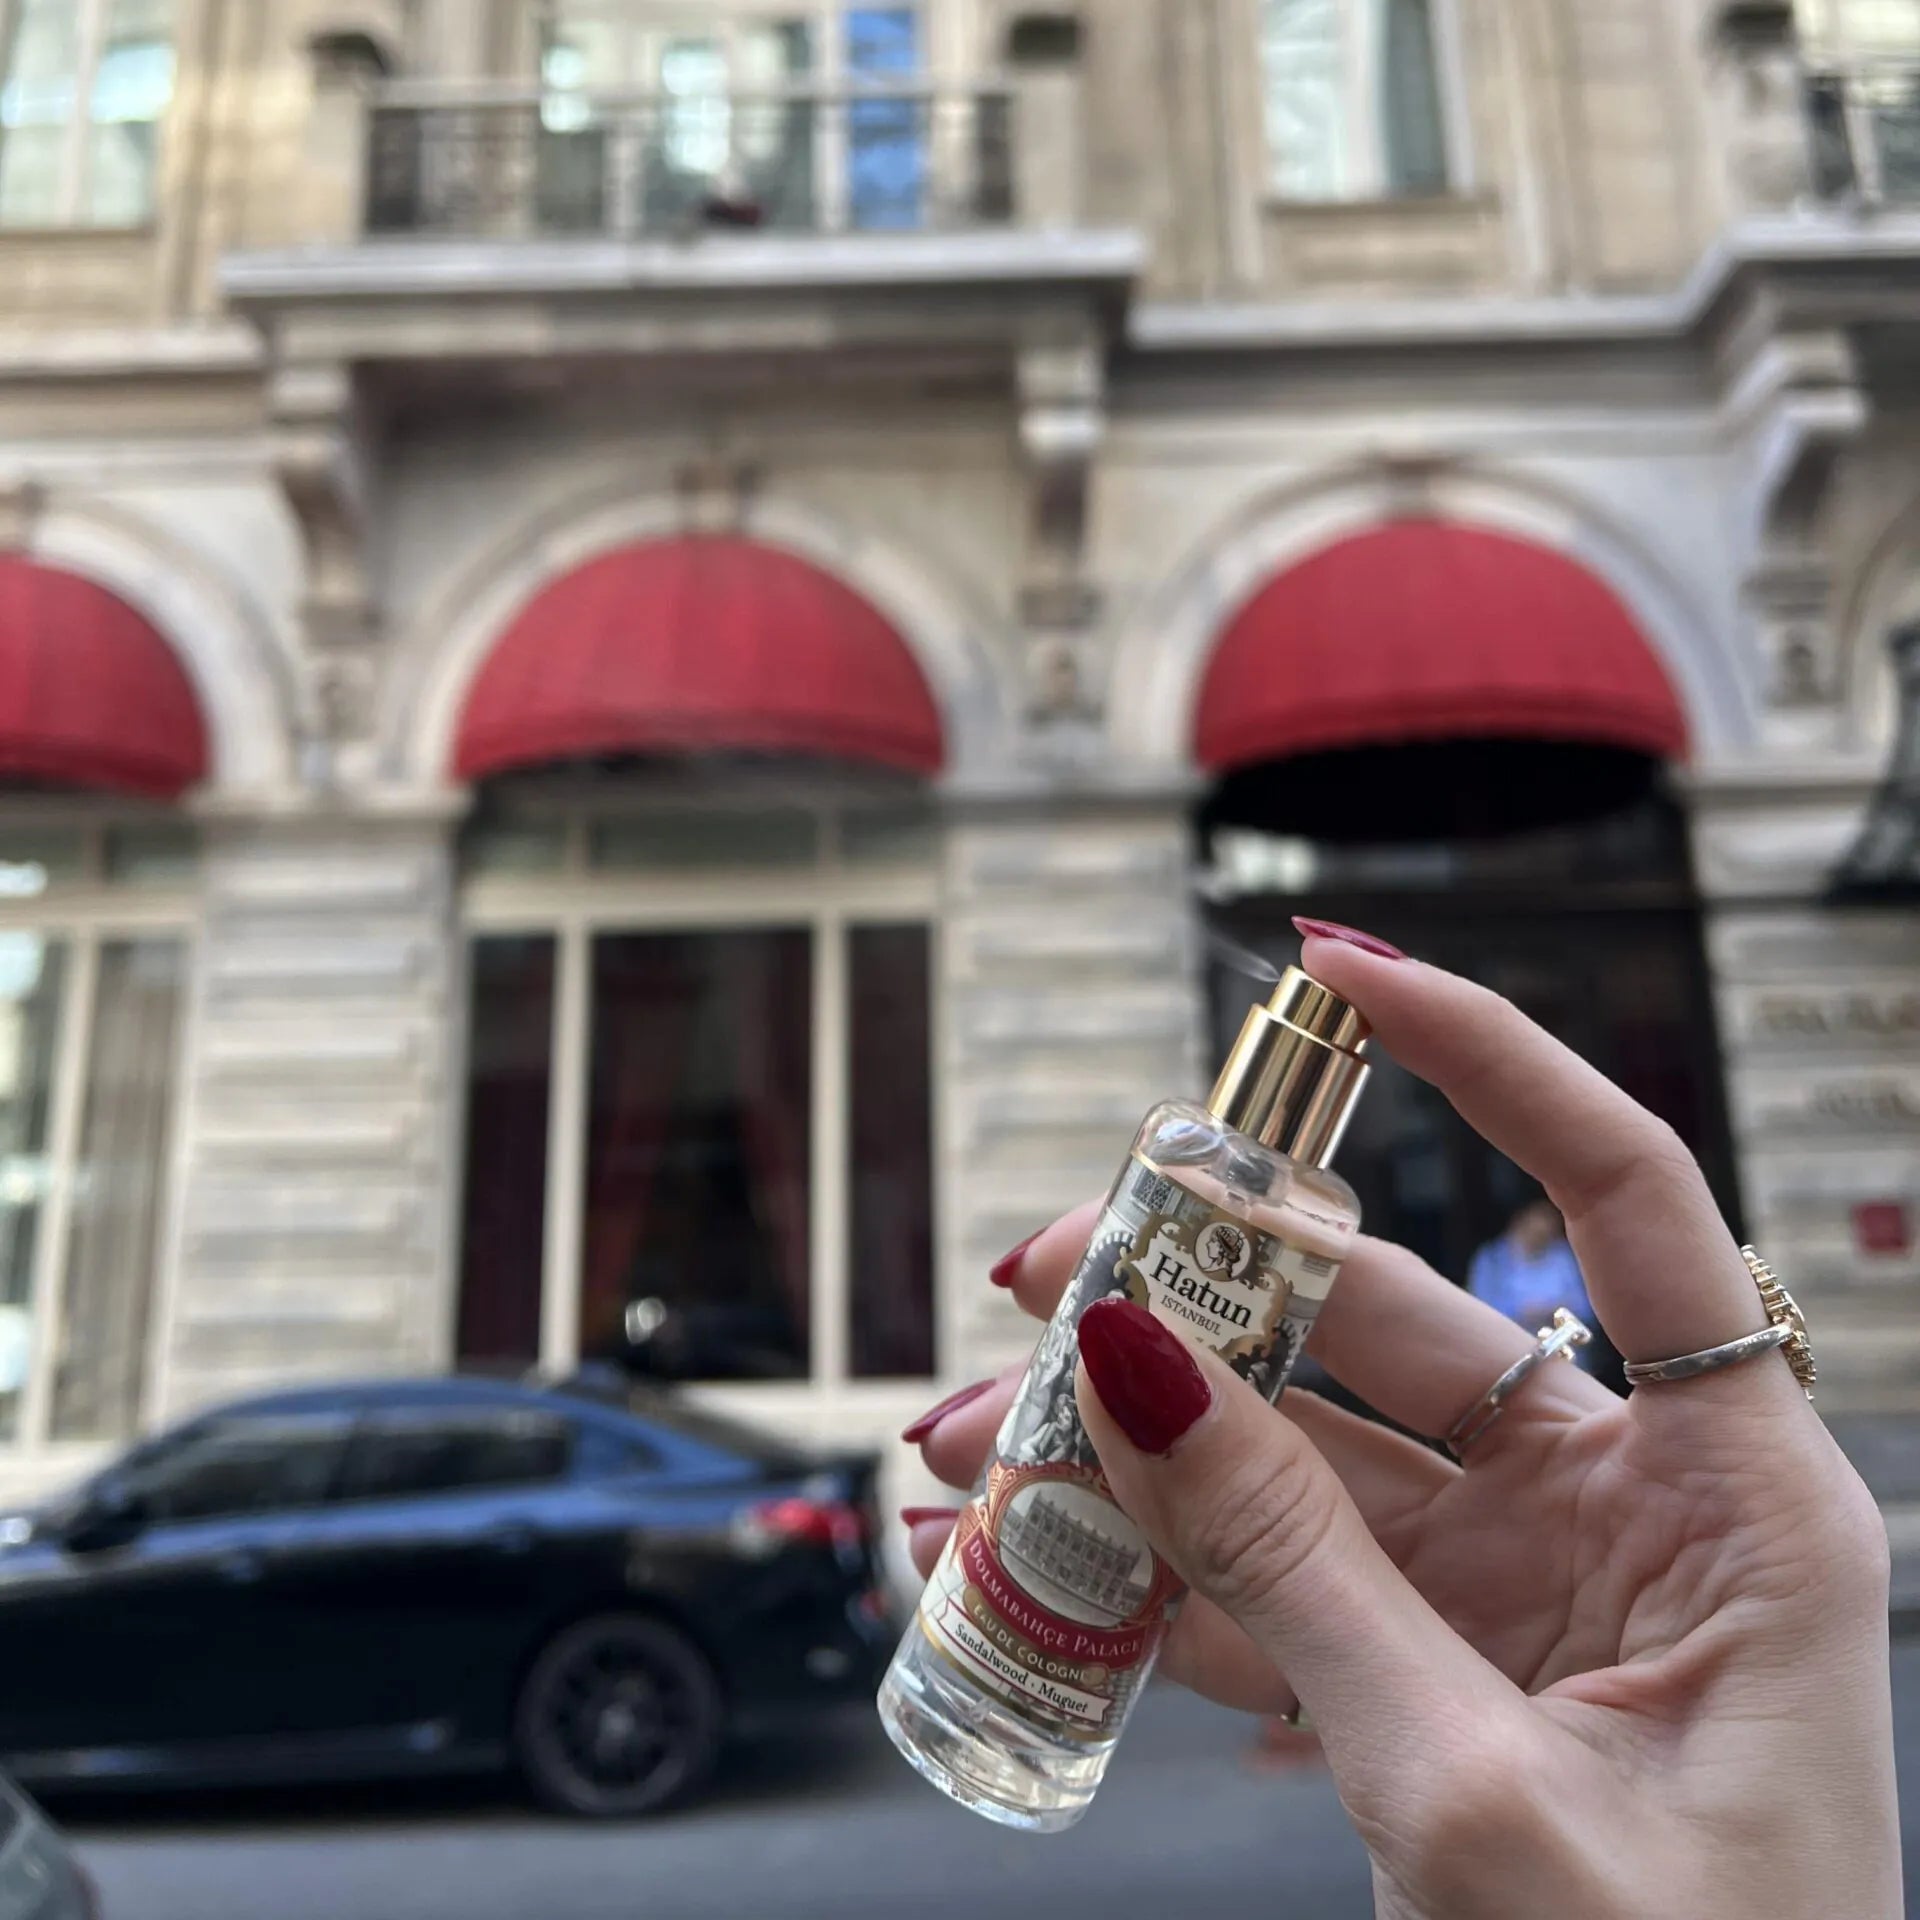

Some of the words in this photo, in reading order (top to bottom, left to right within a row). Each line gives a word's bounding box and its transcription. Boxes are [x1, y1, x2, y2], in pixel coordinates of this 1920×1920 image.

[1149, 1251, 1252, 1329] Hatun
[1160, 1294, 1222, 1336] ISTANBUL
[955, 1623, 1029, 1686] Sandalwood
[1038, 1682, 1089, 1714] Muguet
[996, 1628, 1015, 1649] DE
